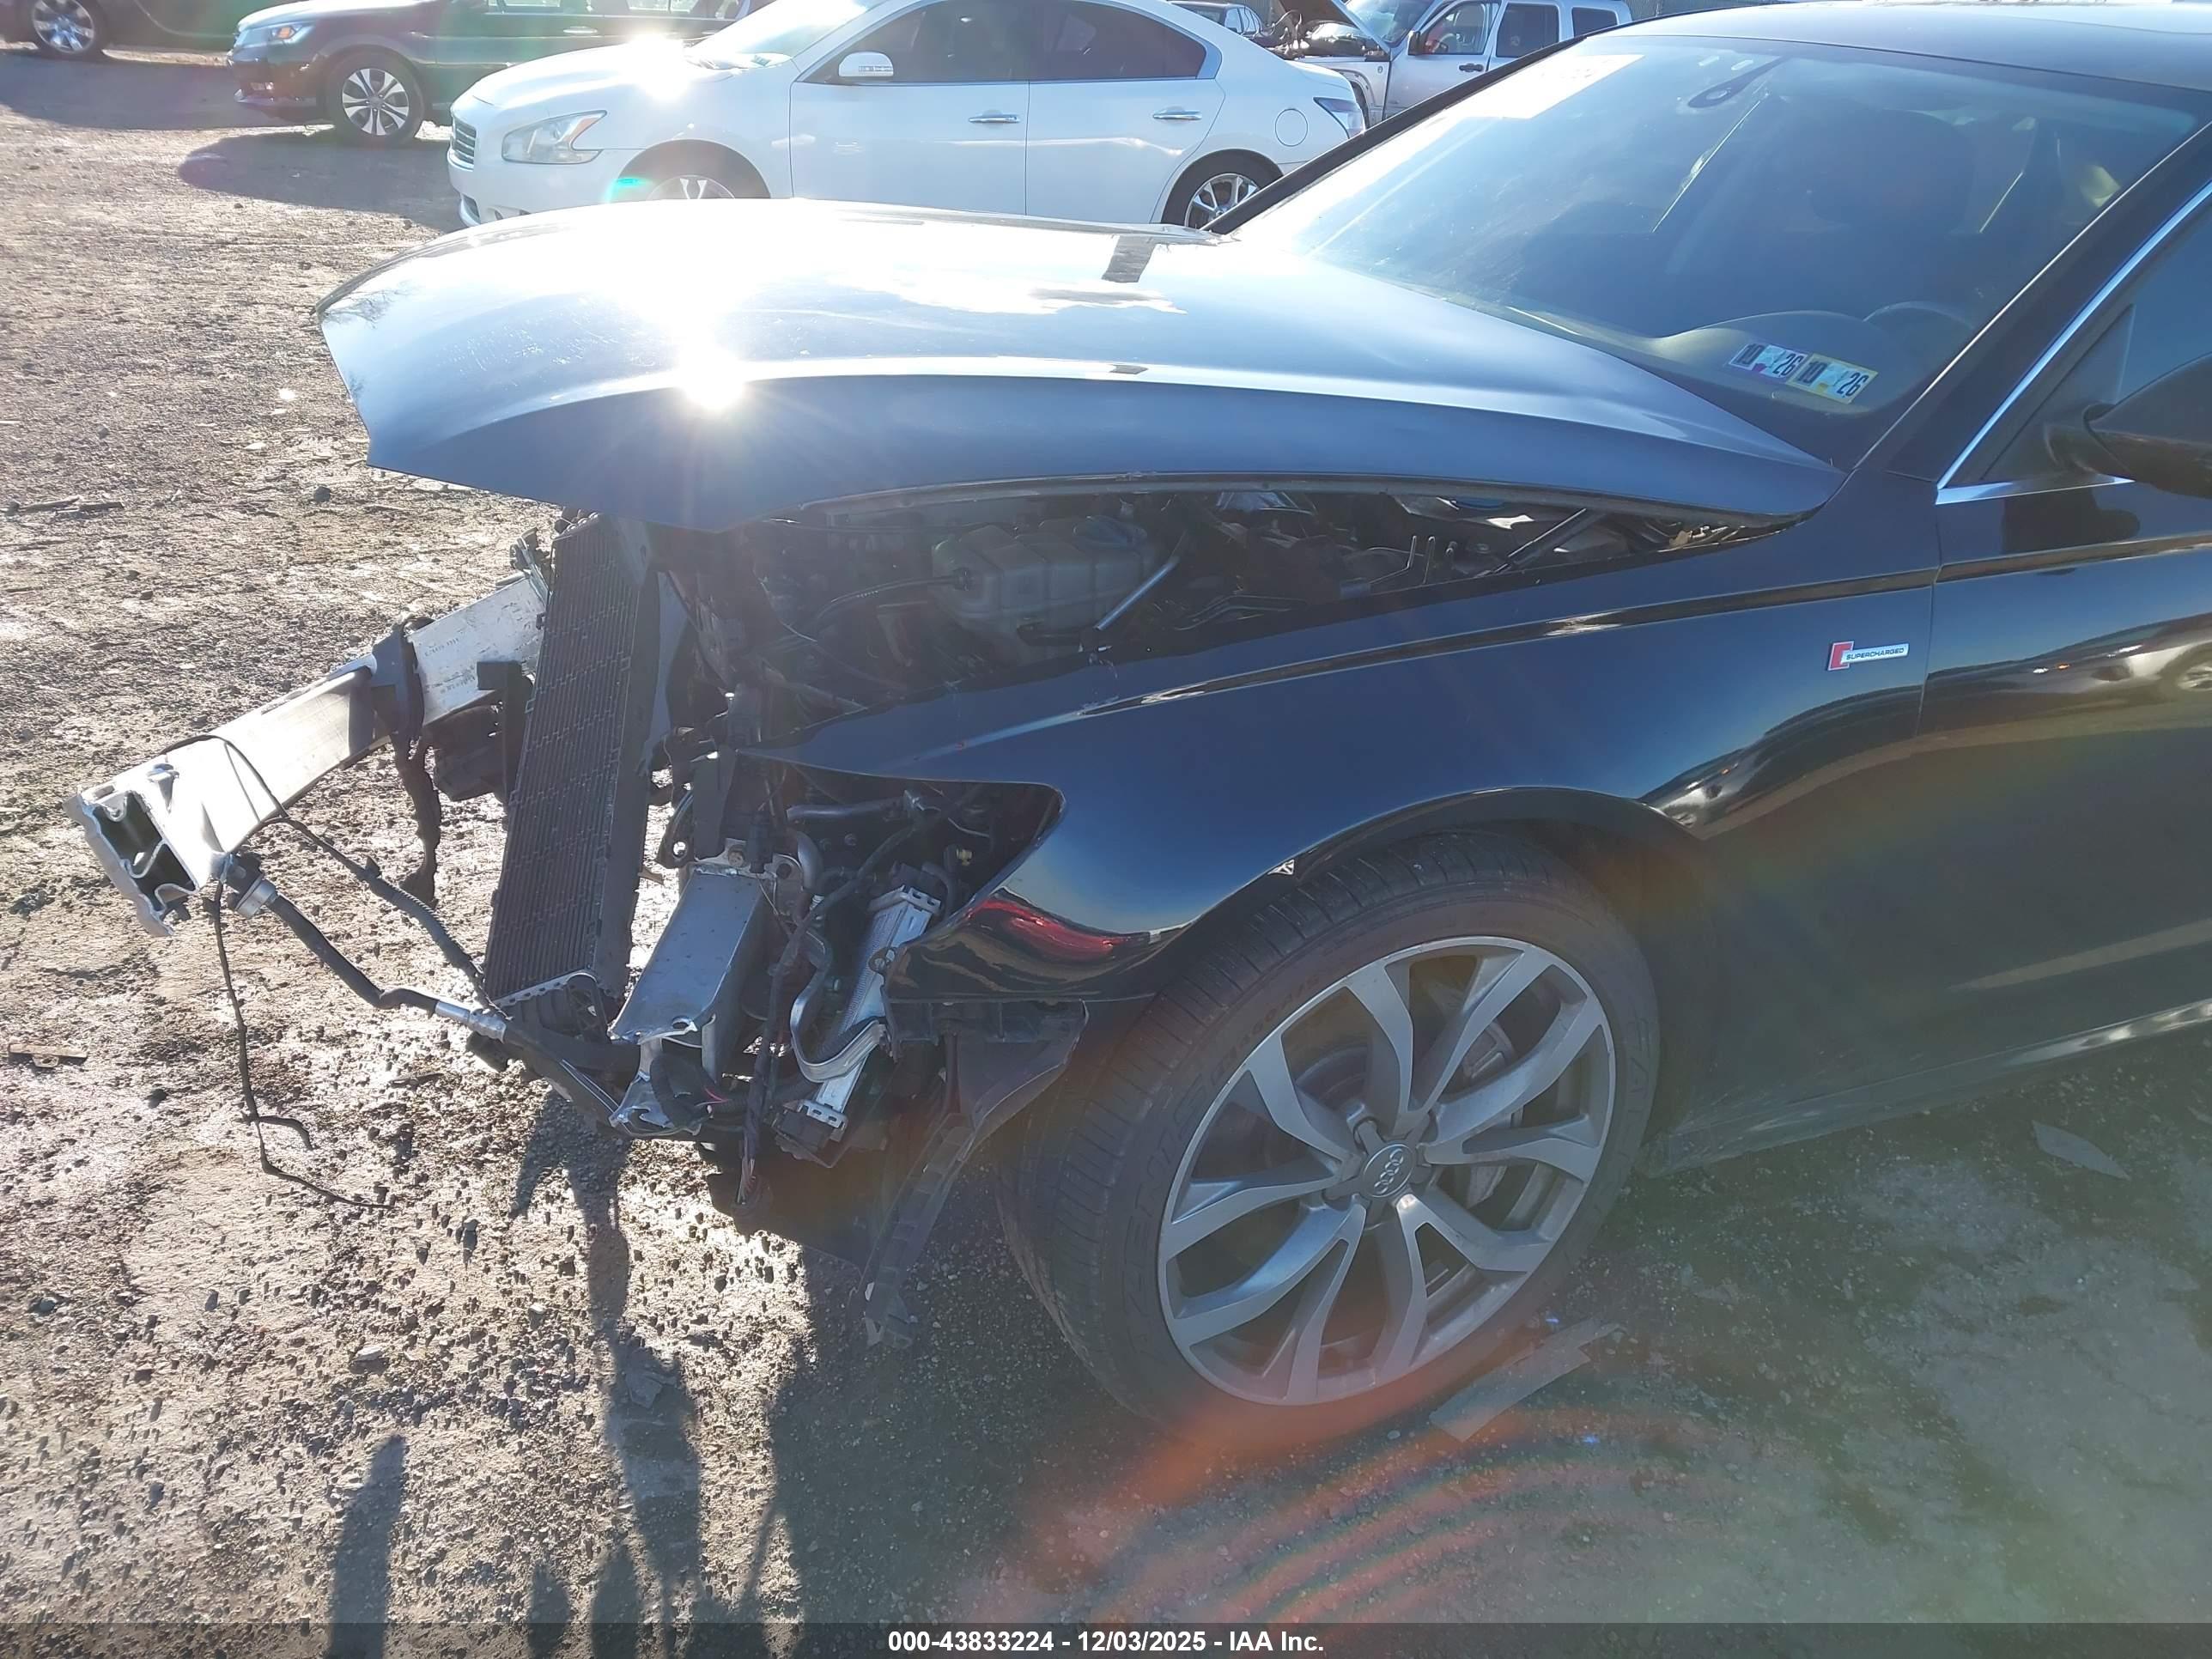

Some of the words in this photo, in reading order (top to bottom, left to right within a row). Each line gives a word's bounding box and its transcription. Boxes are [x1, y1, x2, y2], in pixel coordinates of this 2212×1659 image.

[1736, 343, 1765, 365] 10
[1772, 353, 1804, 376] 26
[1799, 361, 1828, 383] 10
[1836, 372, 1869, 397] 26
[1845, 647, 1905, 660] SUPERCHARGED
